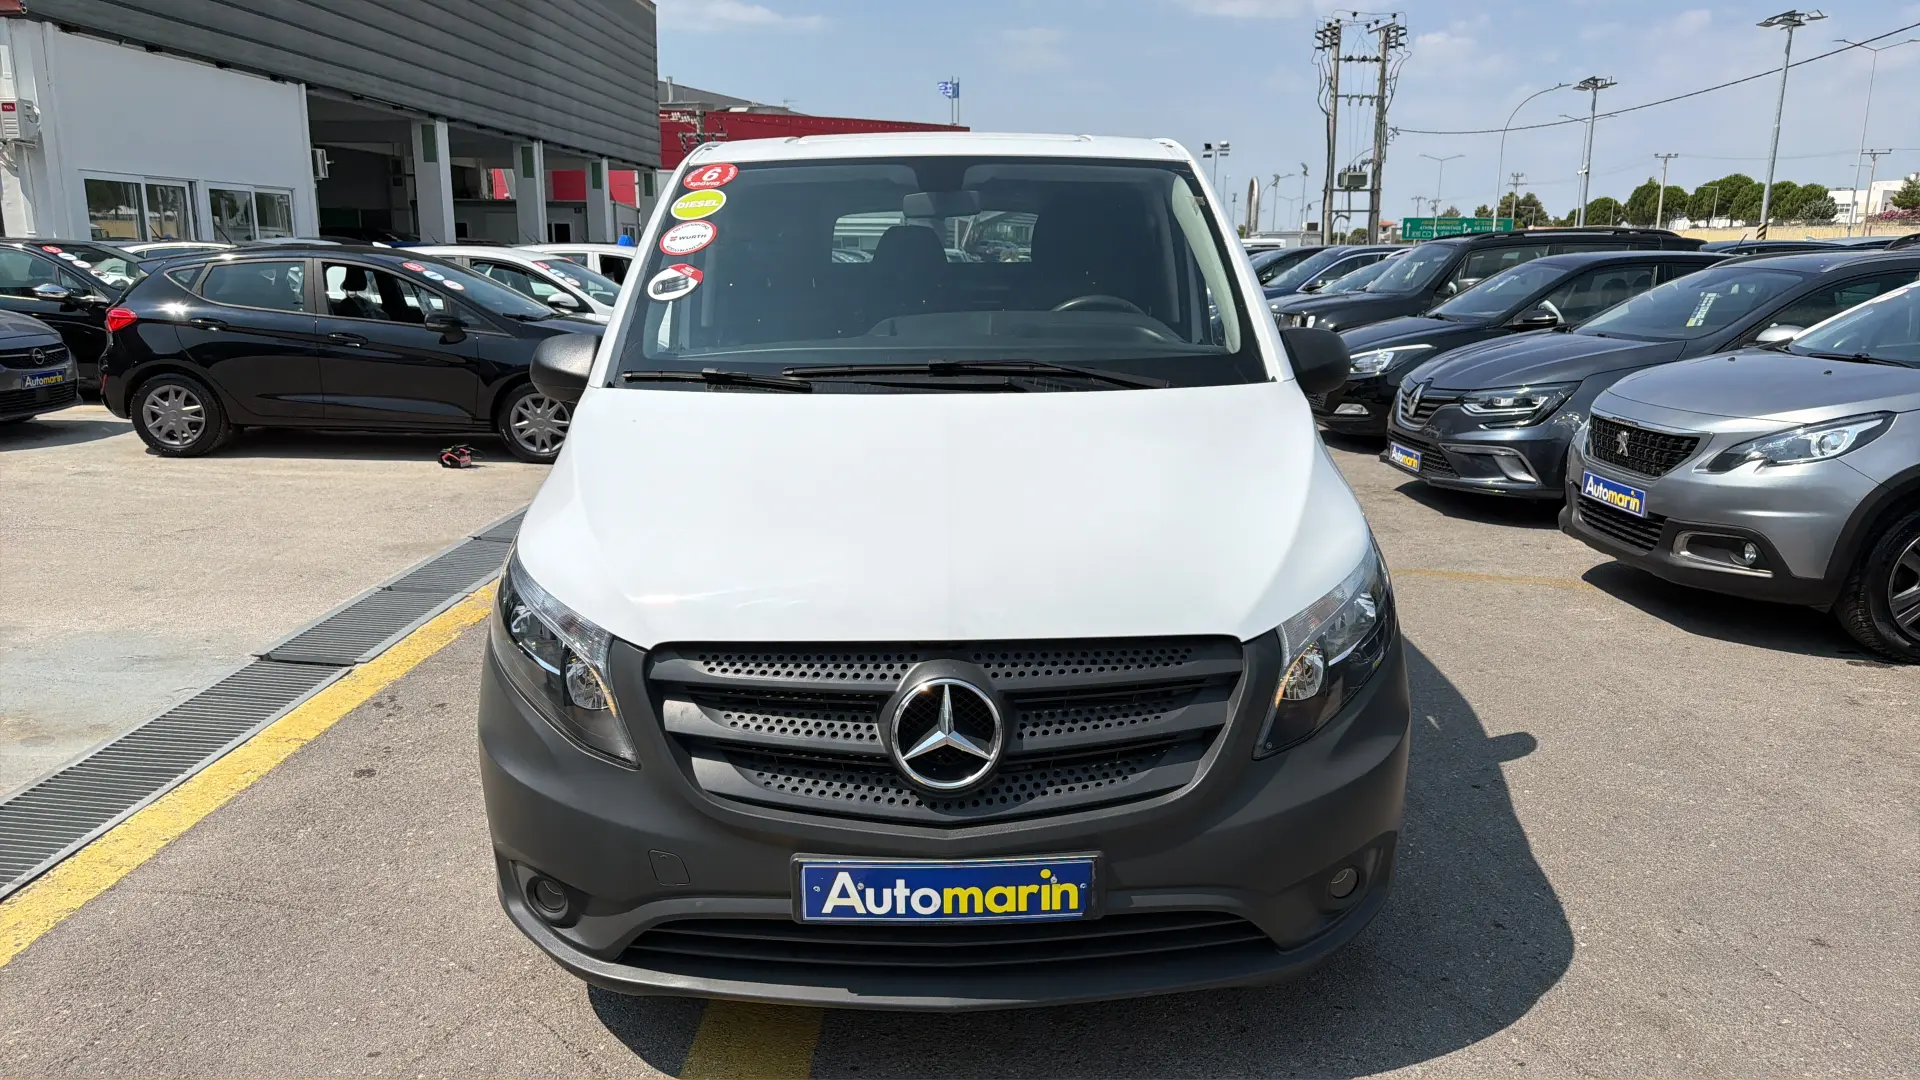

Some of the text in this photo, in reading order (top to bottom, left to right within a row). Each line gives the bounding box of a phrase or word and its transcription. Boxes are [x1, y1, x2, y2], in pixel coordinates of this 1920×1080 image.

[702, 167, 722, 181] 6
[676, 199, 719, 209] DIESEL
[24, 372, 63, 388] Automarin
[1391, 445, 1418, 469] Automarin
[1585, 475, 1640, 512] Automarin
[821, 868, 1079, 915] Automarin
